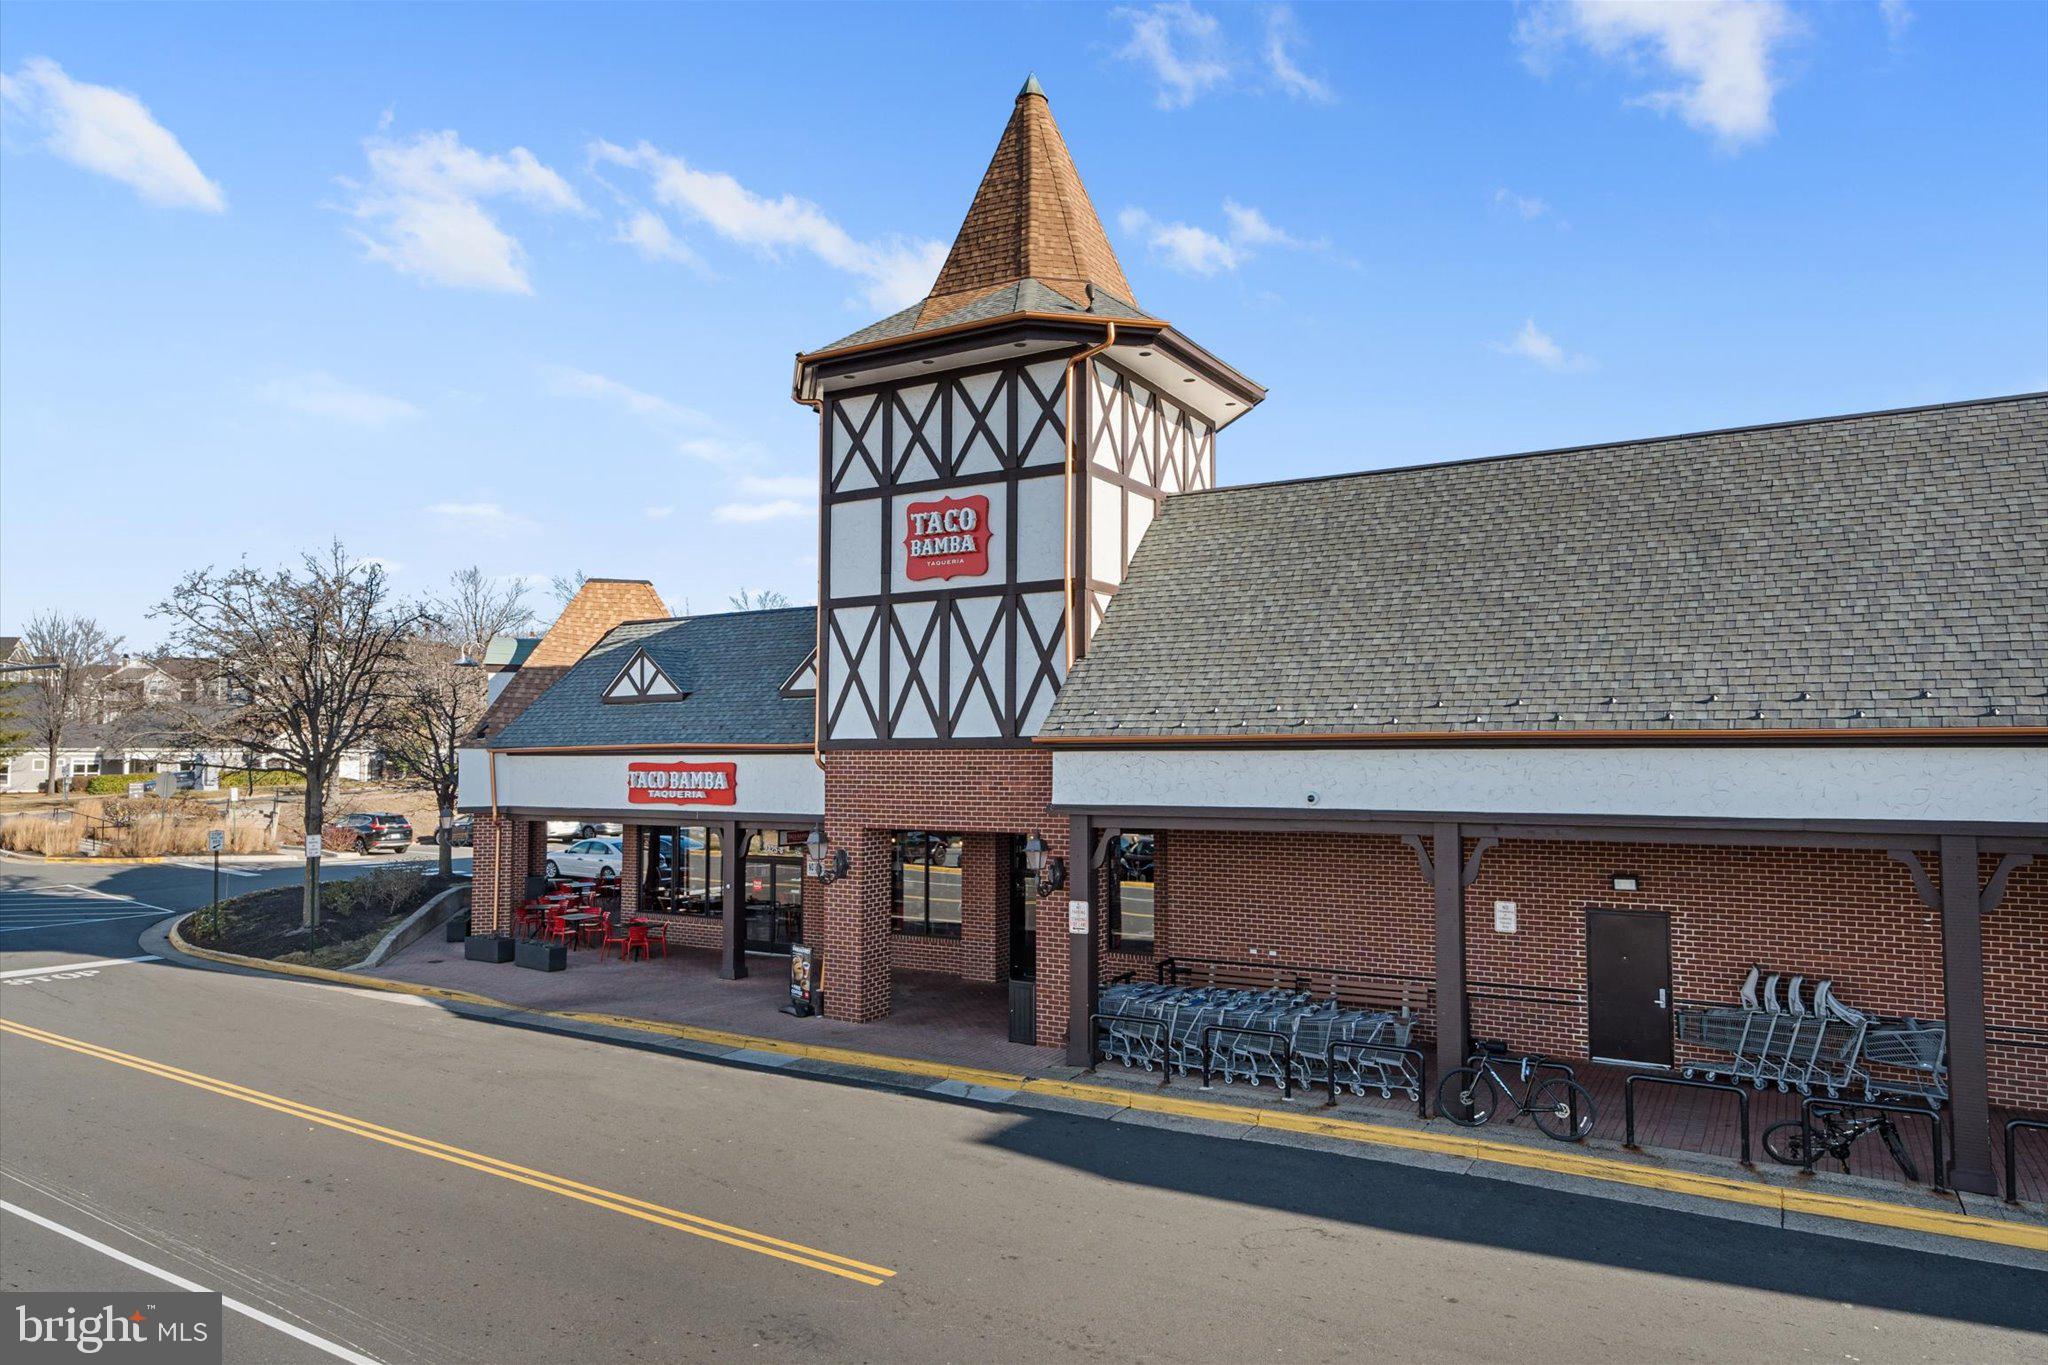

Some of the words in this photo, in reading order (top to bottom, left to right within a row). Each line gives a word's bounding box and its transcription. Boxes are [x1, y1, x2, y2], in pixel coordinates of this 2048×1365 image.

[911, 507, 977, 535] TACO
[911, 534, 977, 557] BAMBA
[927, 559, 965, 567] TAQUERIA
[629, 771, 667, 788] TACO
[670, 771, 729, 789] BAMBA
[648, 790, 706, 798] TAQUERIA
[3, 970, 100, 985] STOP
